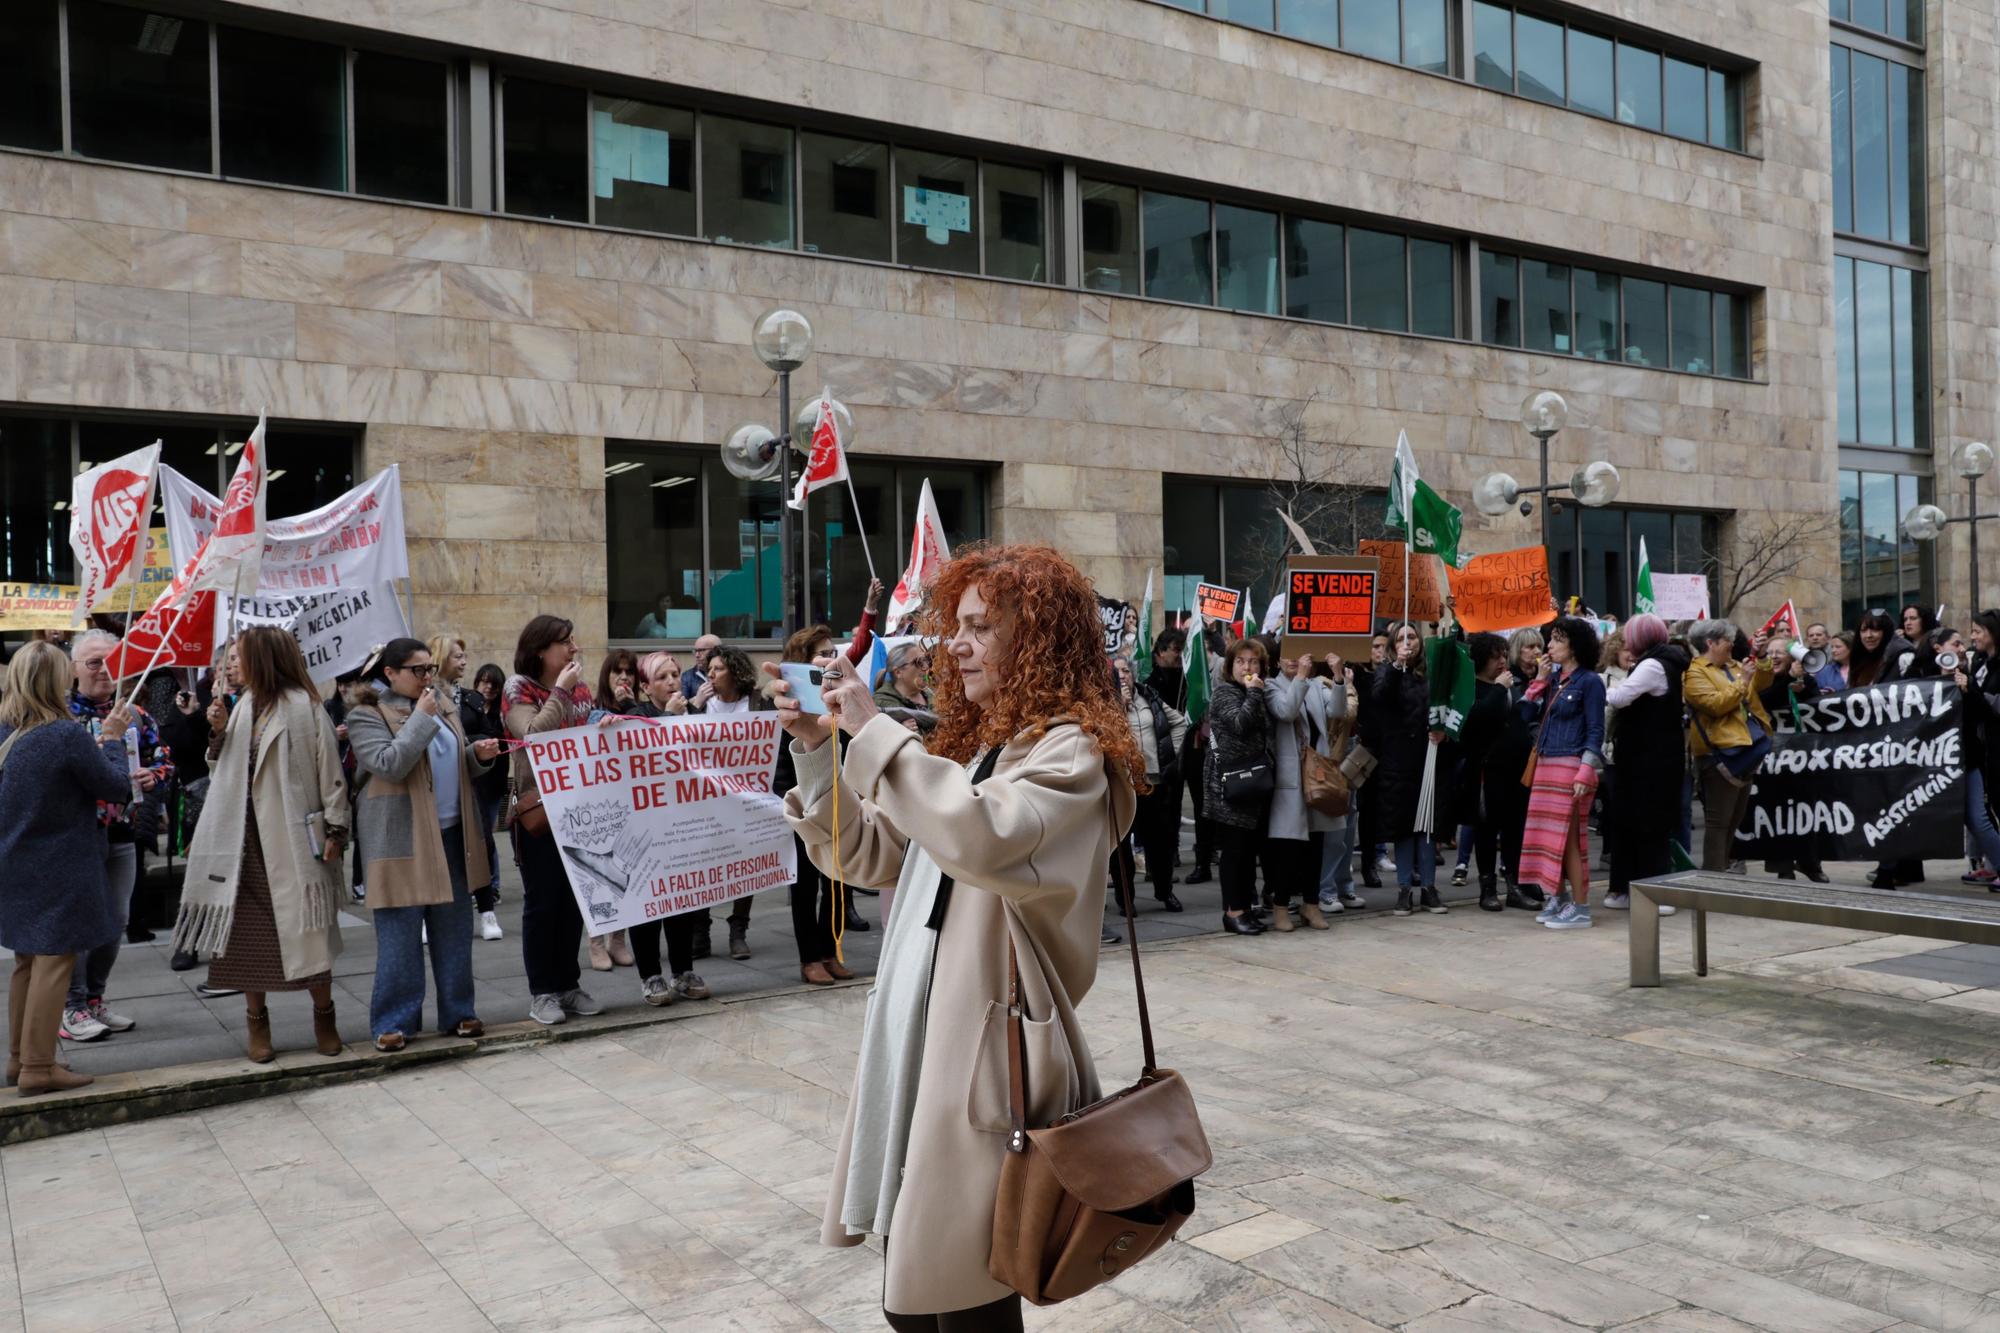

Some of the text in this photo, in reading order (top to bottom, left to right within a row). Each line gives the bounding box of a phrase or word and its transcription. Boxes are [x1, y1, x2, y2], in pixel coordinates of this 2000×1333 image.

[2, 585, 22, 597] LA
[28, 583, 60, 599] ERA
[1199, 586, 1237, 602] SE VENDE
[1293, 574, 1313, 594] SE
[1317, 574, 1372, 594] VENDE
[1457, 582, 1474, 598] NO
[308, 590, 373, 637] NEGOCIAR
[1774, 681, 1953, 735] ERSONAL
[533, 715, 777, 766] POR LA HUMANIZACIÓN
[538, 743, 774, 794] DE LAS RESIDENCIAS
[632, 771, 769, 811] DE MAYORES
[569, 810, 592, 829] NO
[644, 868, 792, 918] ES UN MALTRATO INSTITUCIONAL
[650, 878, 667, 897] LA
[669, 870, 706, 893] FALTA
[709, 866, 724, 885] DE
[726, 851, 781, 880] PERSONAL
